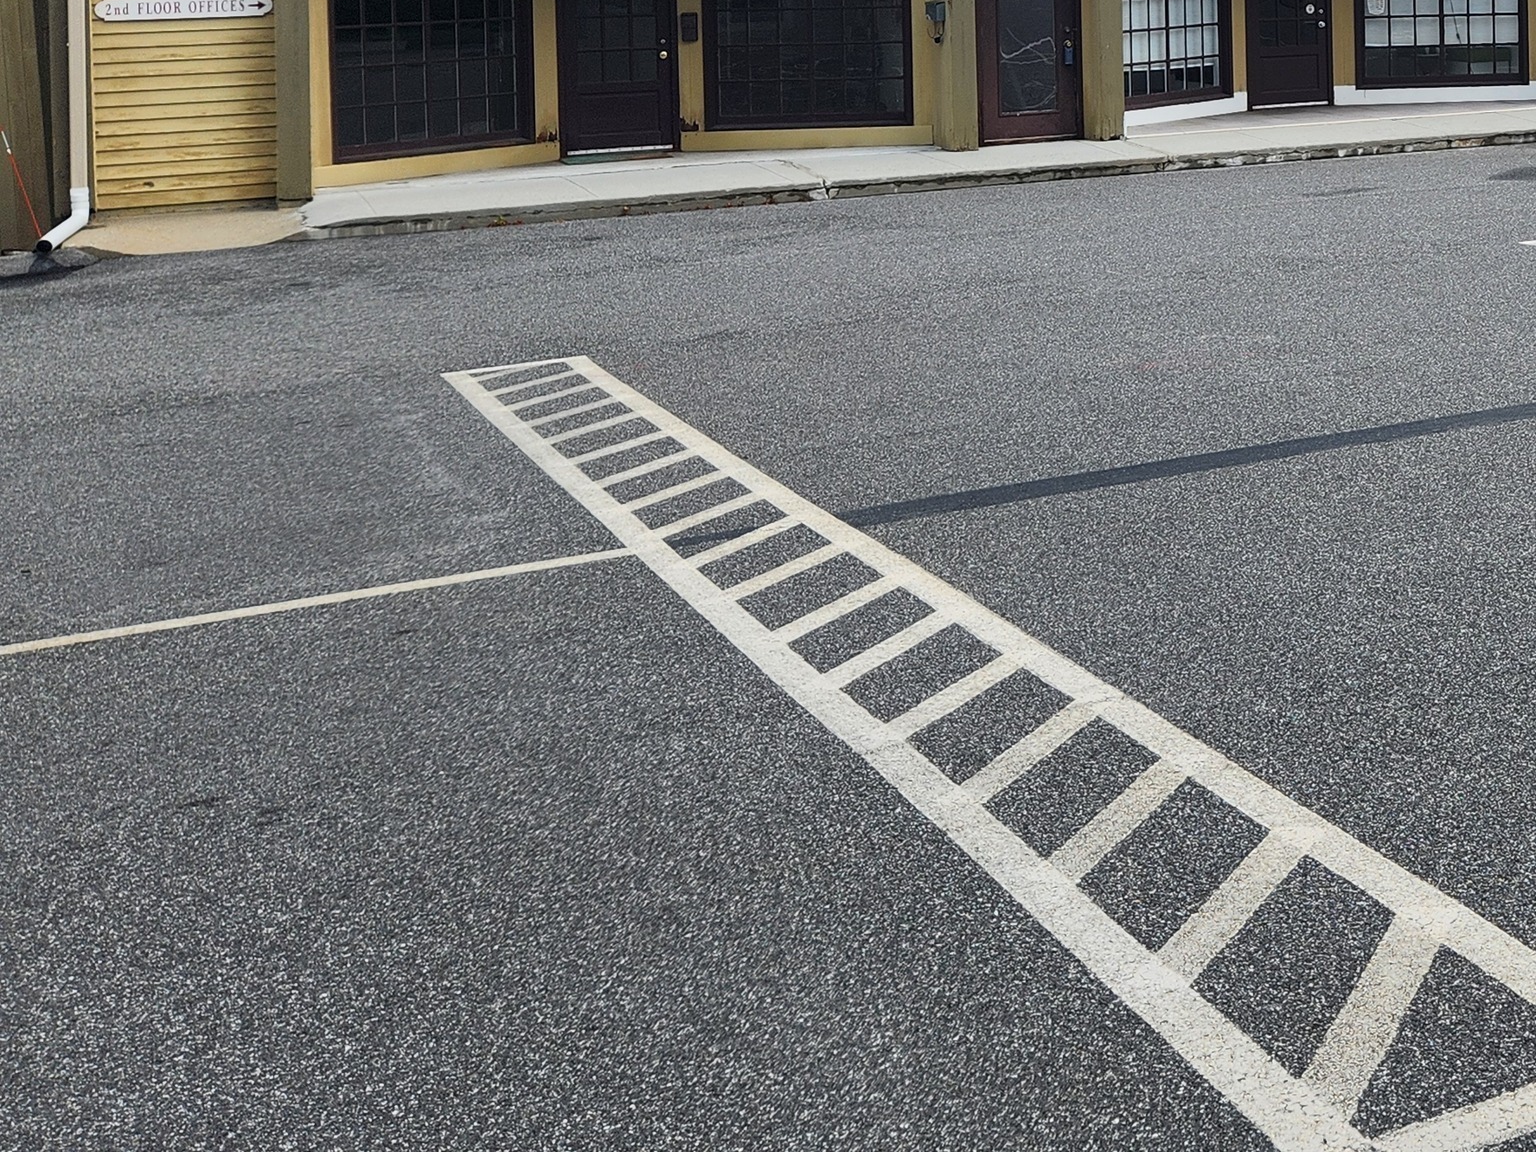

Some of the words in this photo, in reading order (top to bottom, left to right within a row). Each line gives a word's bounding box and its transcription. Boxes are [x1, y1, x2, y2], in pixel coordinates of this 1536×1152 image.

[105, 3, 129, 16] 2nd
[137, 1, 182, 15] FLOOR
[188, 0, 245, 13] OFFICES
